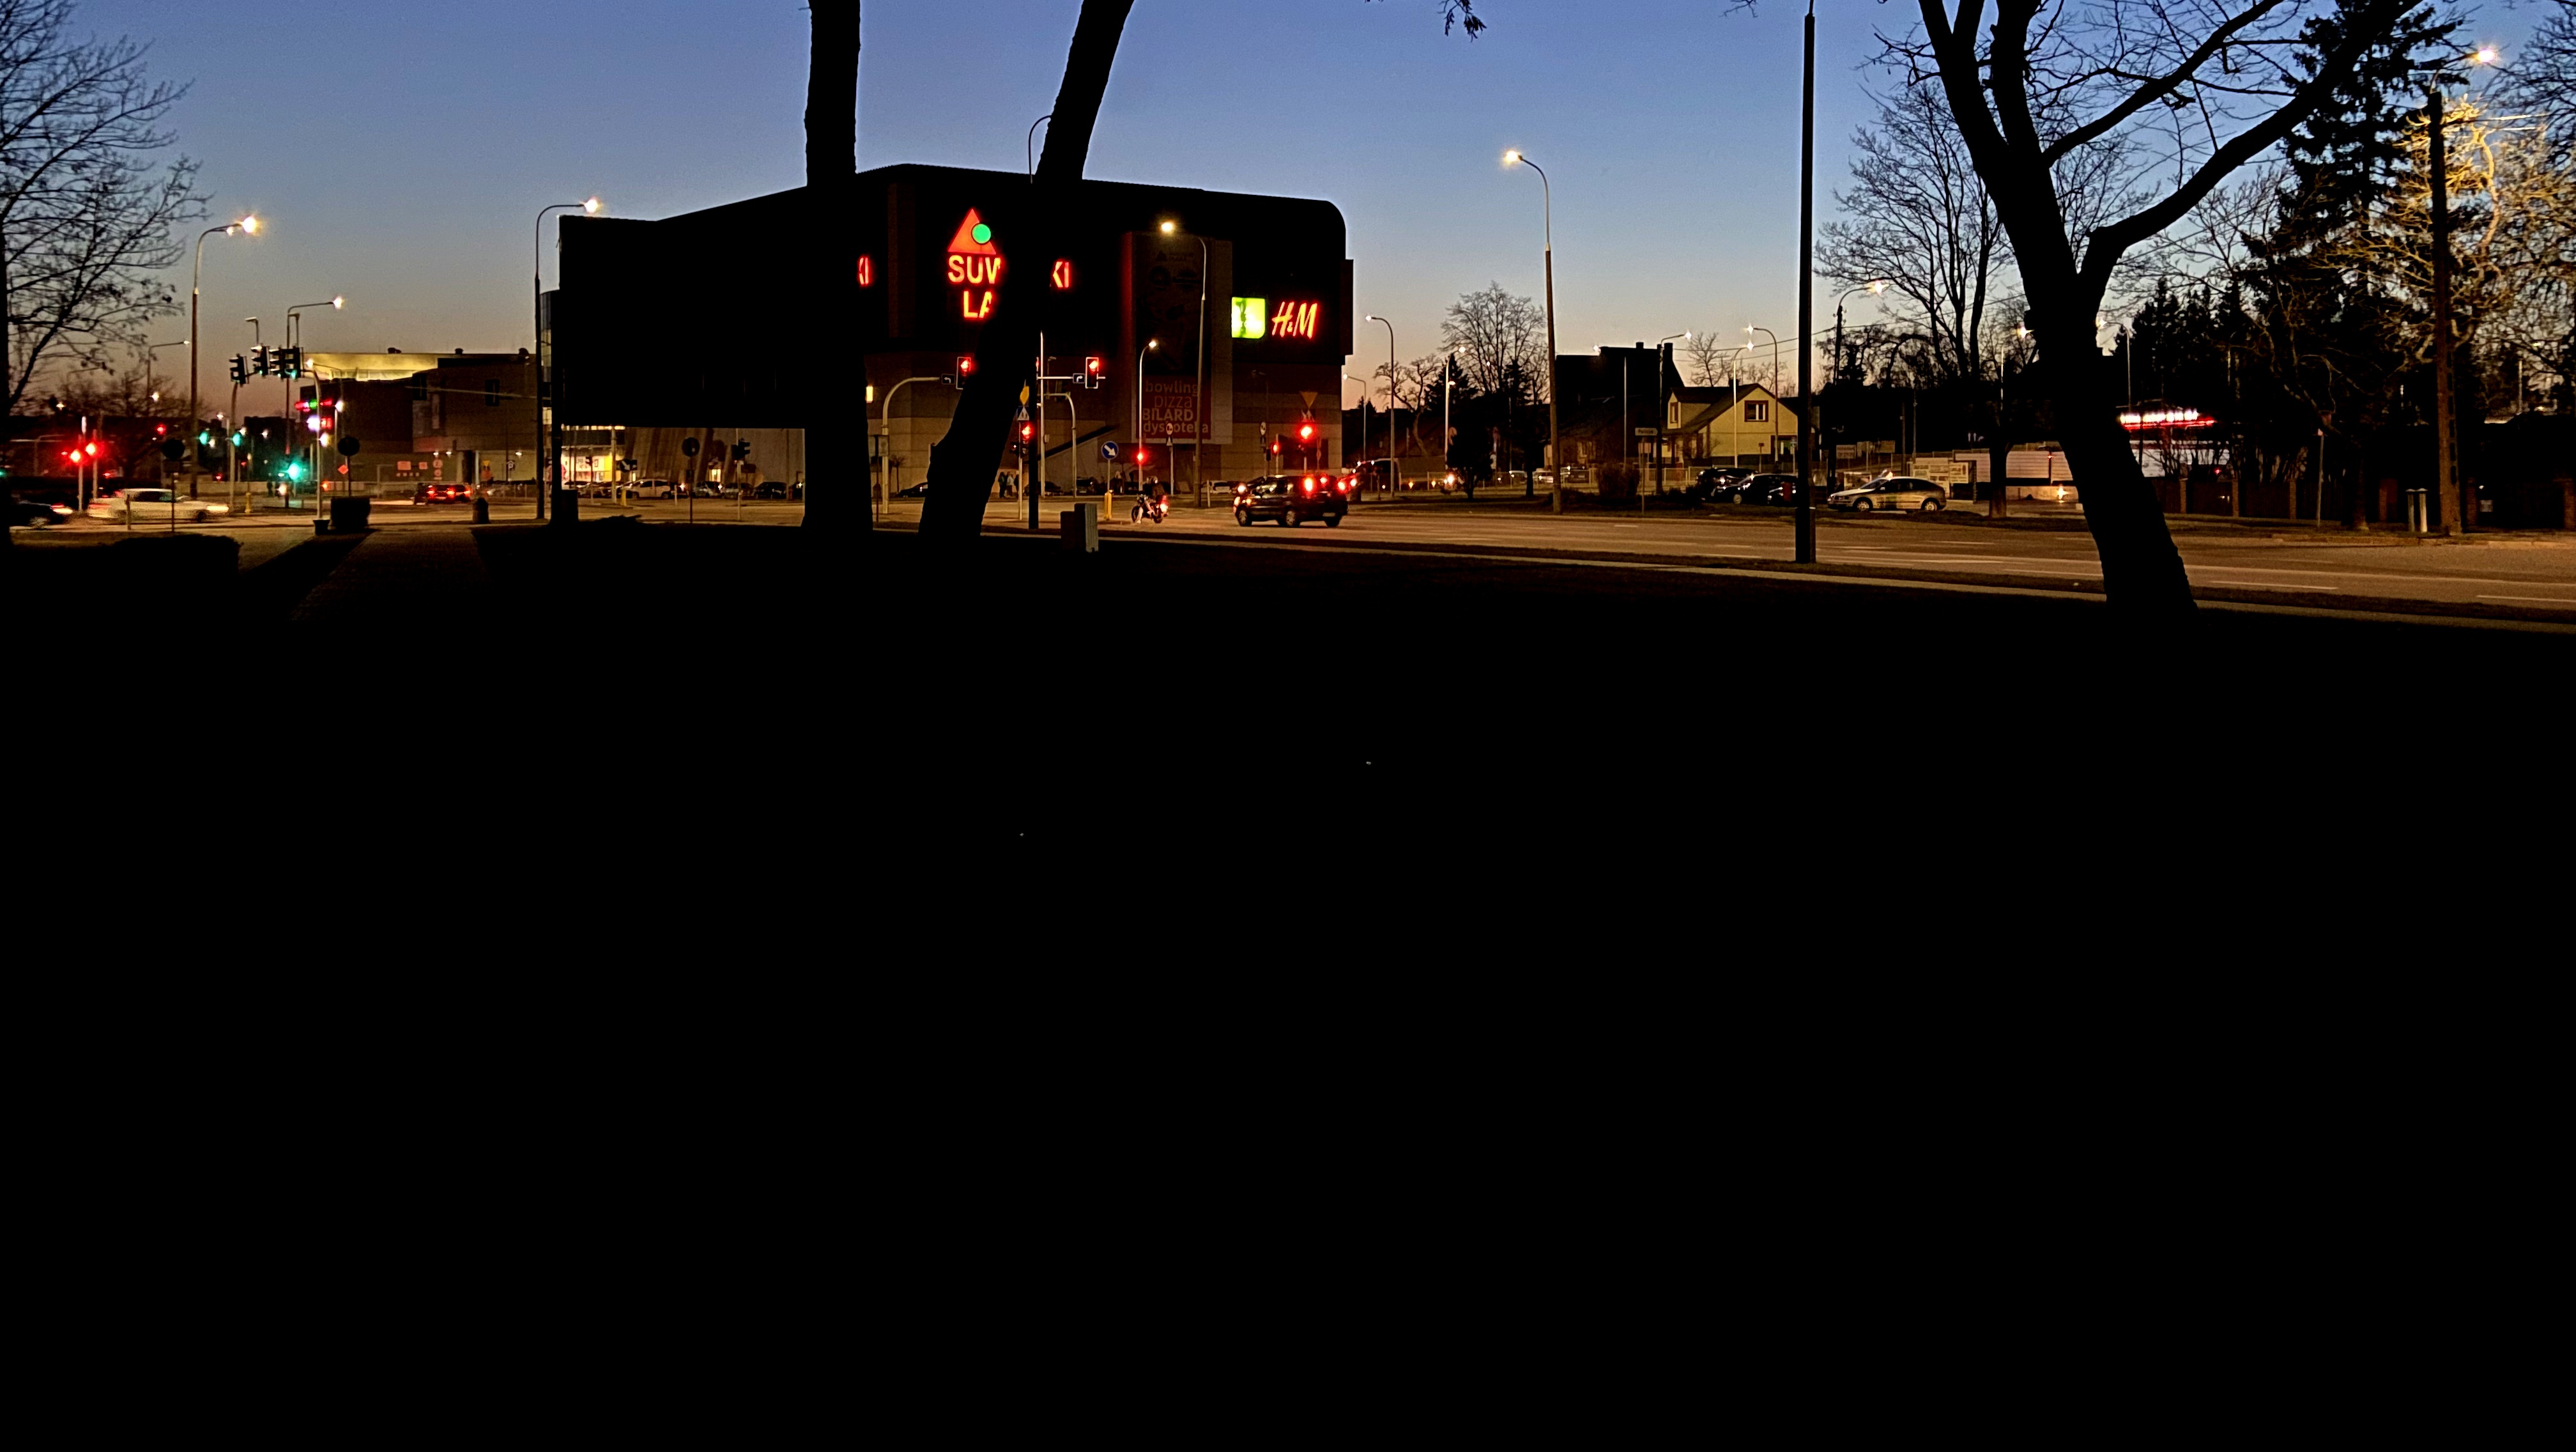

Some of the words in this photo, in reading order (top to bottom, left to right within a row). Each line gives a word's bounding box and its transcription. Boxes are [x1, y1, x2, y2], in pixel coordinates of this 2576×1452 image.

[1271, 301, 1318, 339] H&M
[1145, 380, 1199, 397] bowling
[1154, 394, 1193, 410] pizza
[1142, 408, 1194, 421] BILARD
[1143, 420, 1209, 435] dysotea
